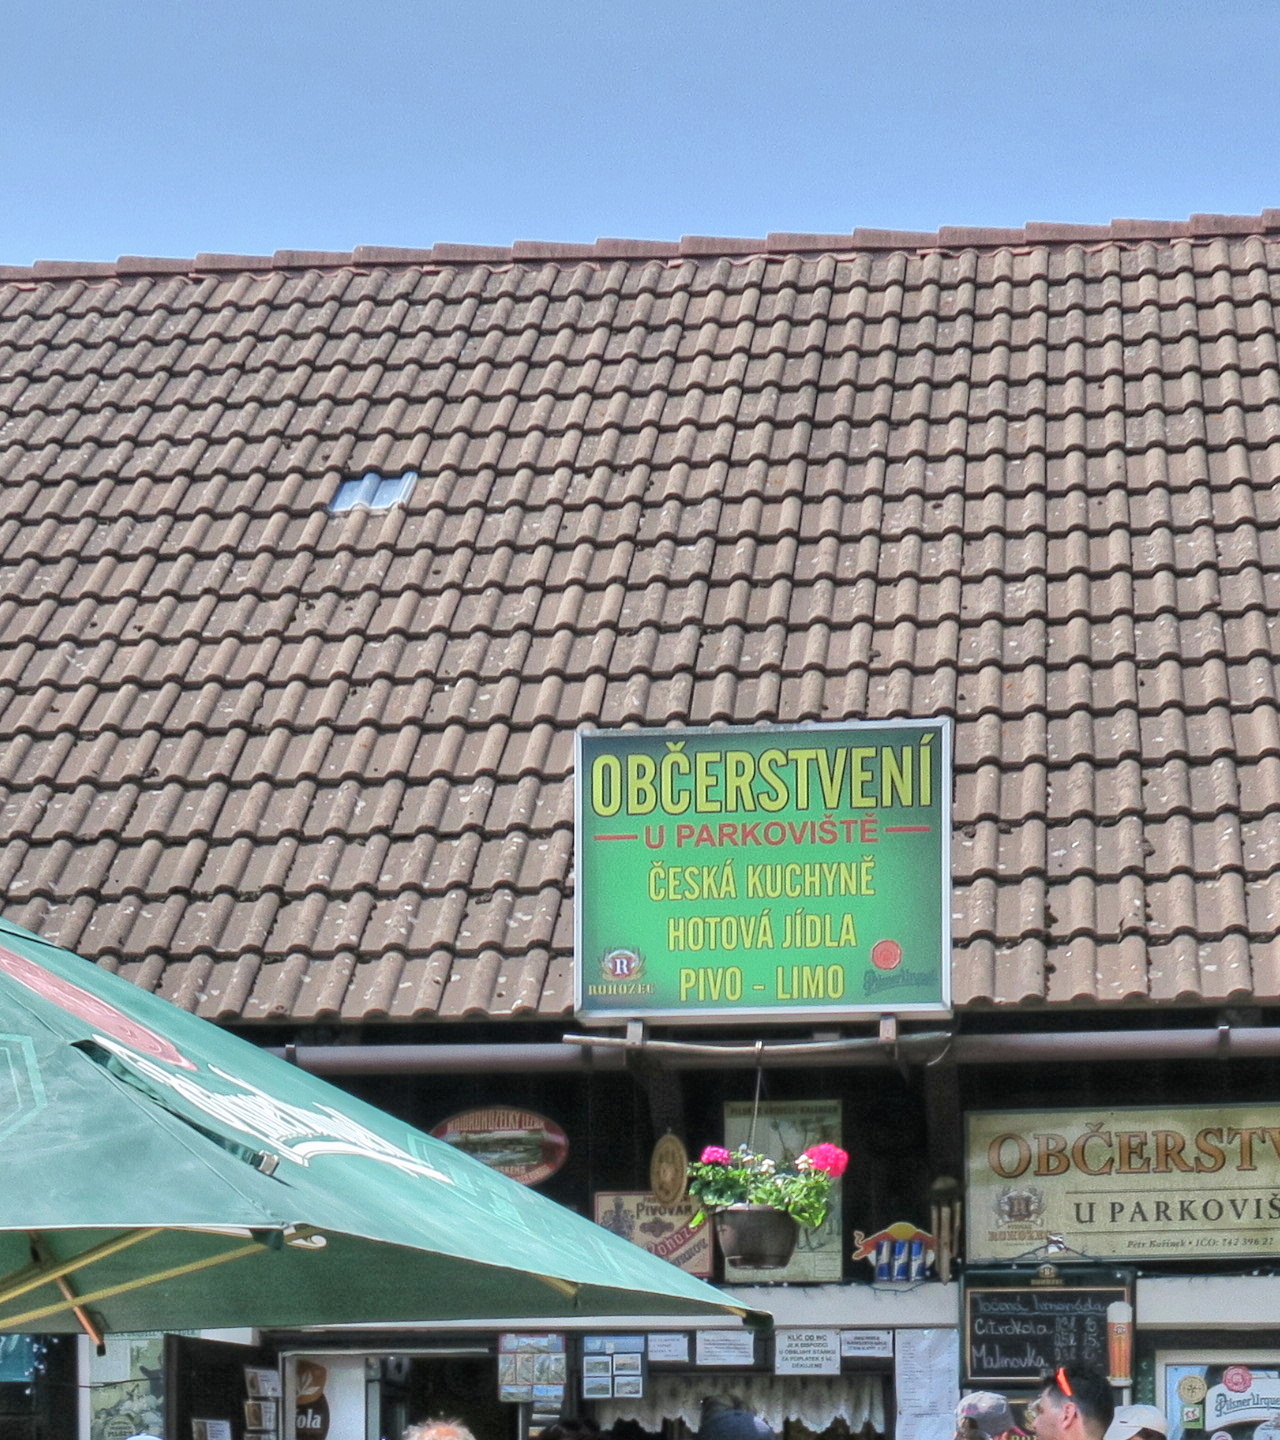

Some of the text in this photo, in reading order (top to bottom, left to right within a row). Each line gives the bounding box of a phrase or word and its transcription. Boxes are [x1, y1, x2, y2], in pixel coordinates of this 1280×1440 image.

[591, 733, 934, 817] OBČERSTVENÍ
[645, 813, 879, 849] U PARKOVIŠTĚ
[649, 855, 876, 901] ČESKÁ KUCHYNĚ
[668, 907, 858, 951] HOTOVÁ JÍDLA
[588, 982, 655, 996] ROHOZEC
[680, 967, 742, 1001] PIVO
[776, 965, 845, 1000] LIMO
[636, 1202, 693, 1219] PIVOVAR
[1074, 1202, 1096, 1223] U
[296, 1409, 322, 1429] ola
